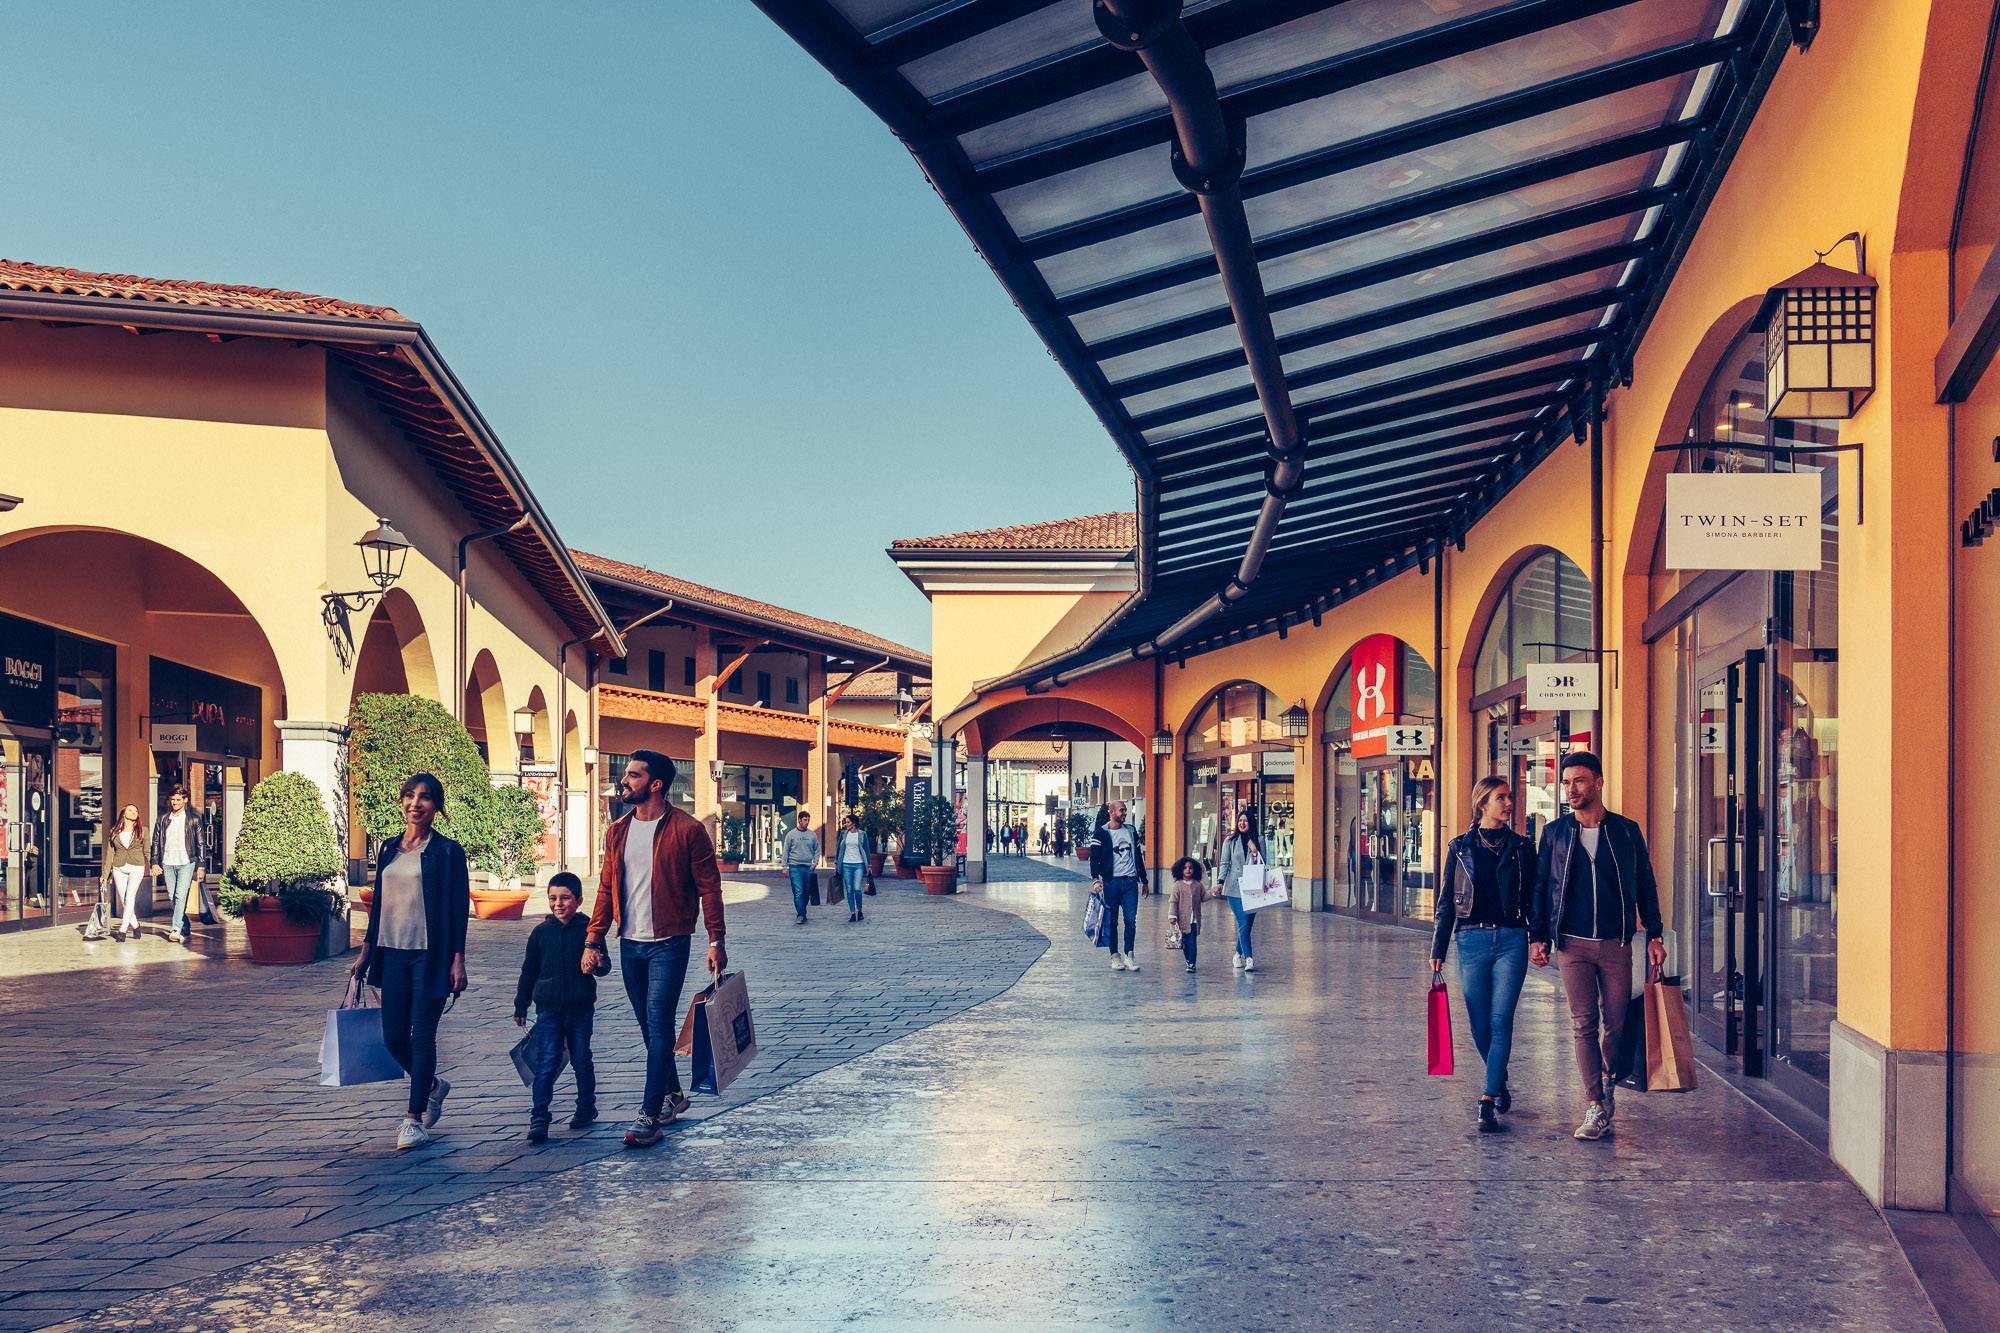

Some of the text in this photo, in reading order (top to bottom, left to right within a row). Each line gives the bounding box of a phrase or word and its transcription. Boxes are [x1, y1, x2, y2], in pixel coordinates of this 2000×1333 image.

[1680, 515, 1808, 527] TWIN-SET
[4, 656, 43, 682] BOGGI
[192, 699, 225, 727] PUPA
